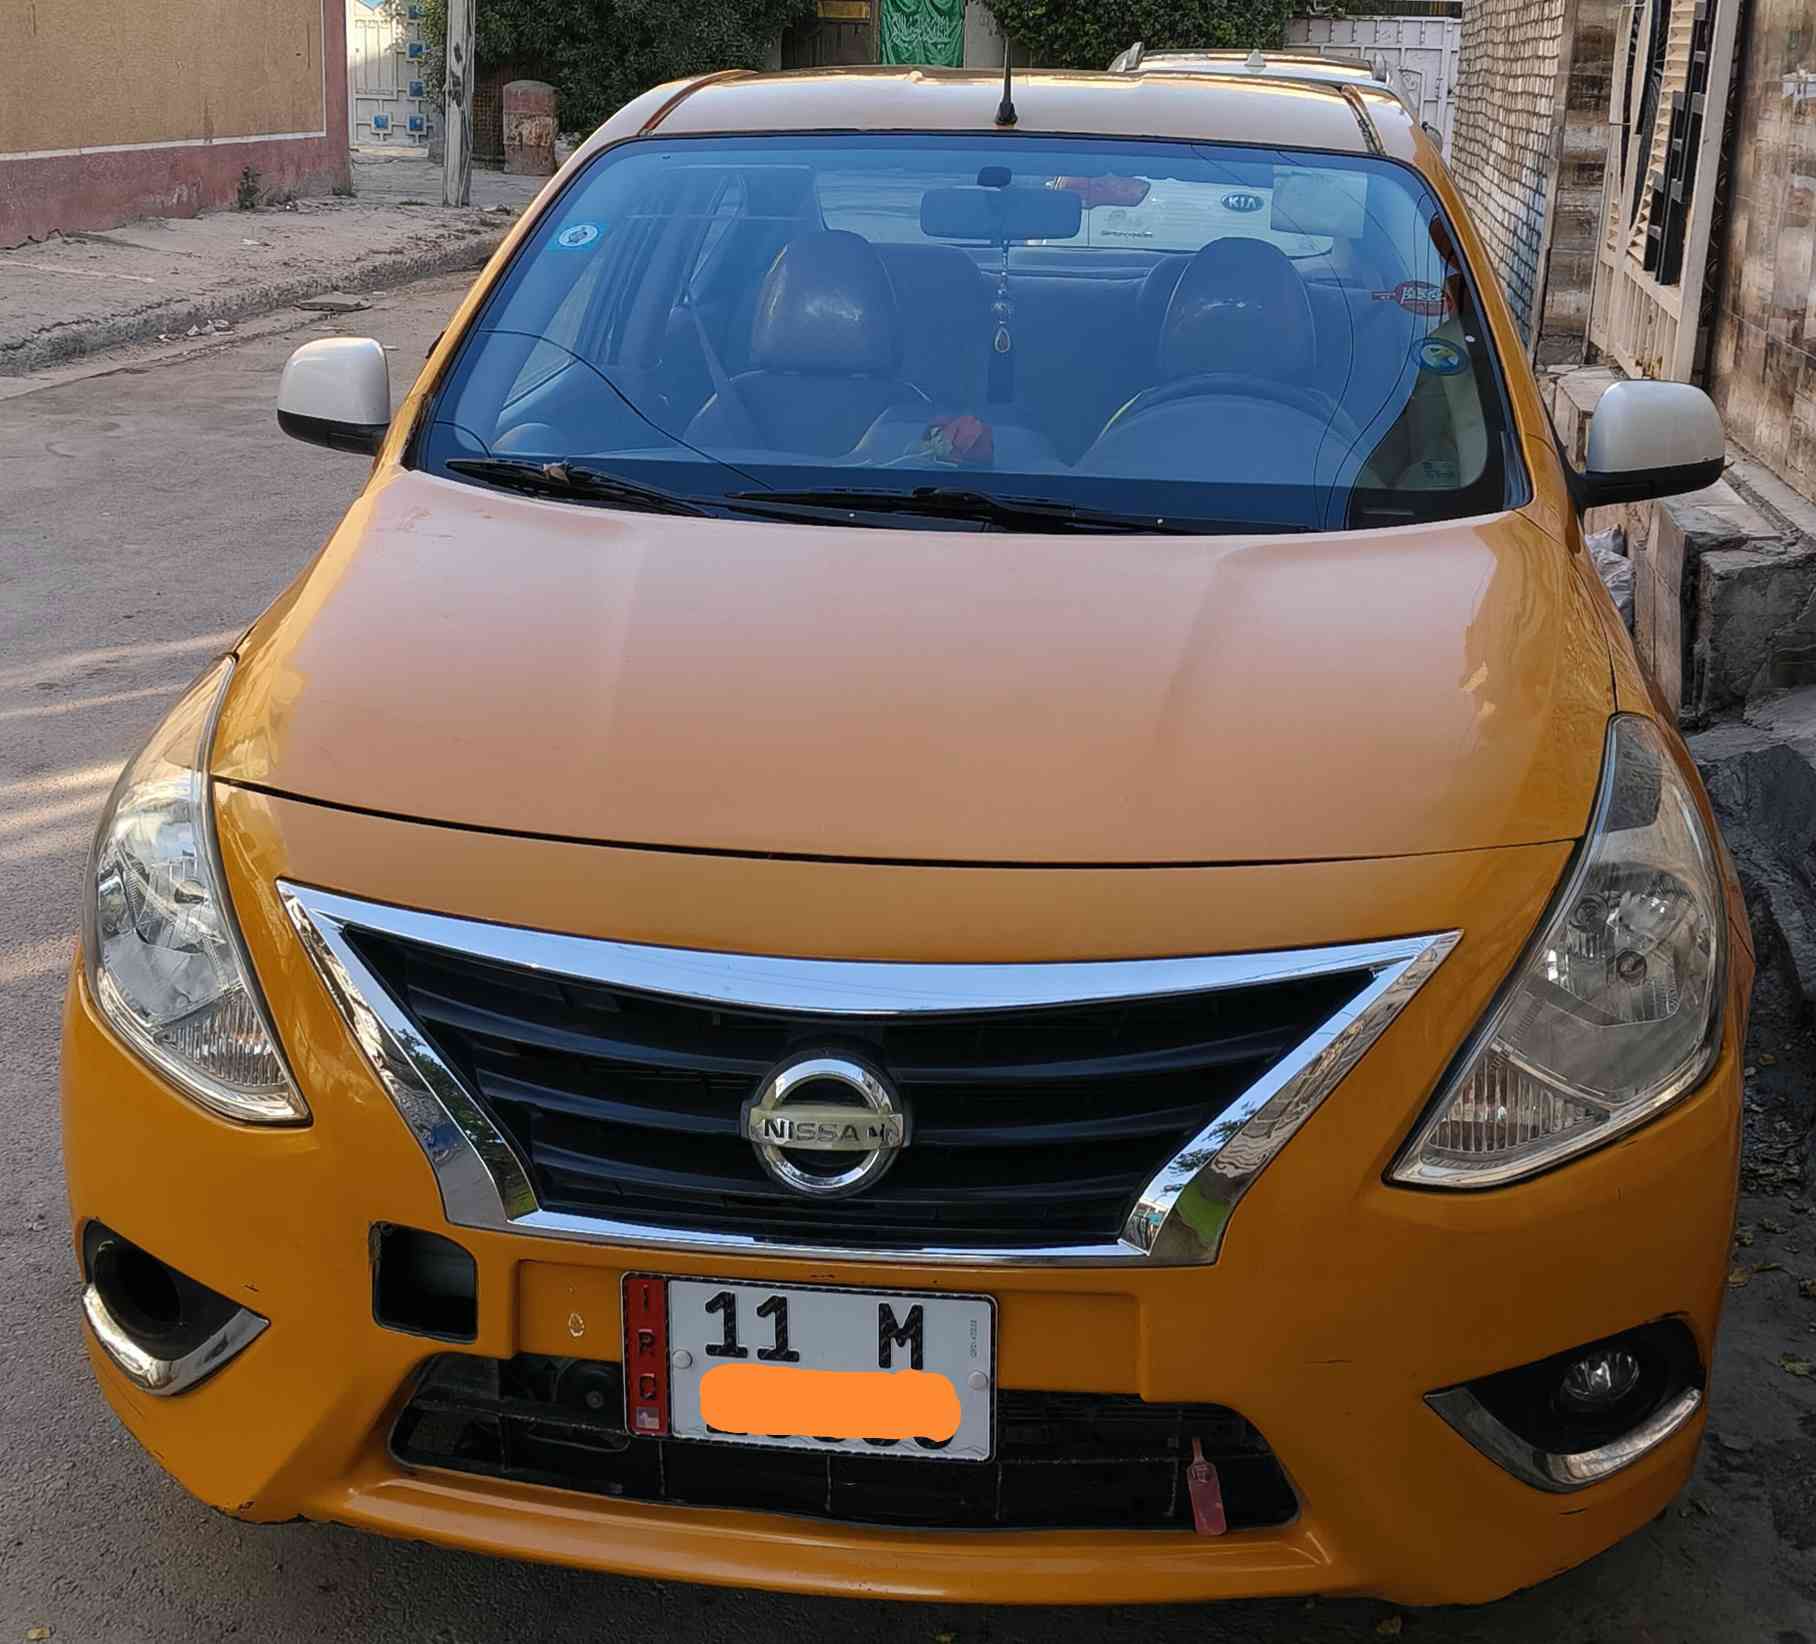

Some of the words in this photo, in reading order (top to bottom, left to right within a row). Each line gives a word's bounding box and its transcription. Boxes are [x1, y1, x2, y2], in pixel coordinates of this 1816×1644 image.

[1228, 196, 1257, 208] KIA
[762, 1117, 886, 1144] NISSAN
[704, 1291, 800, 1362] 11
[878, 1302, 924, 1370] M
